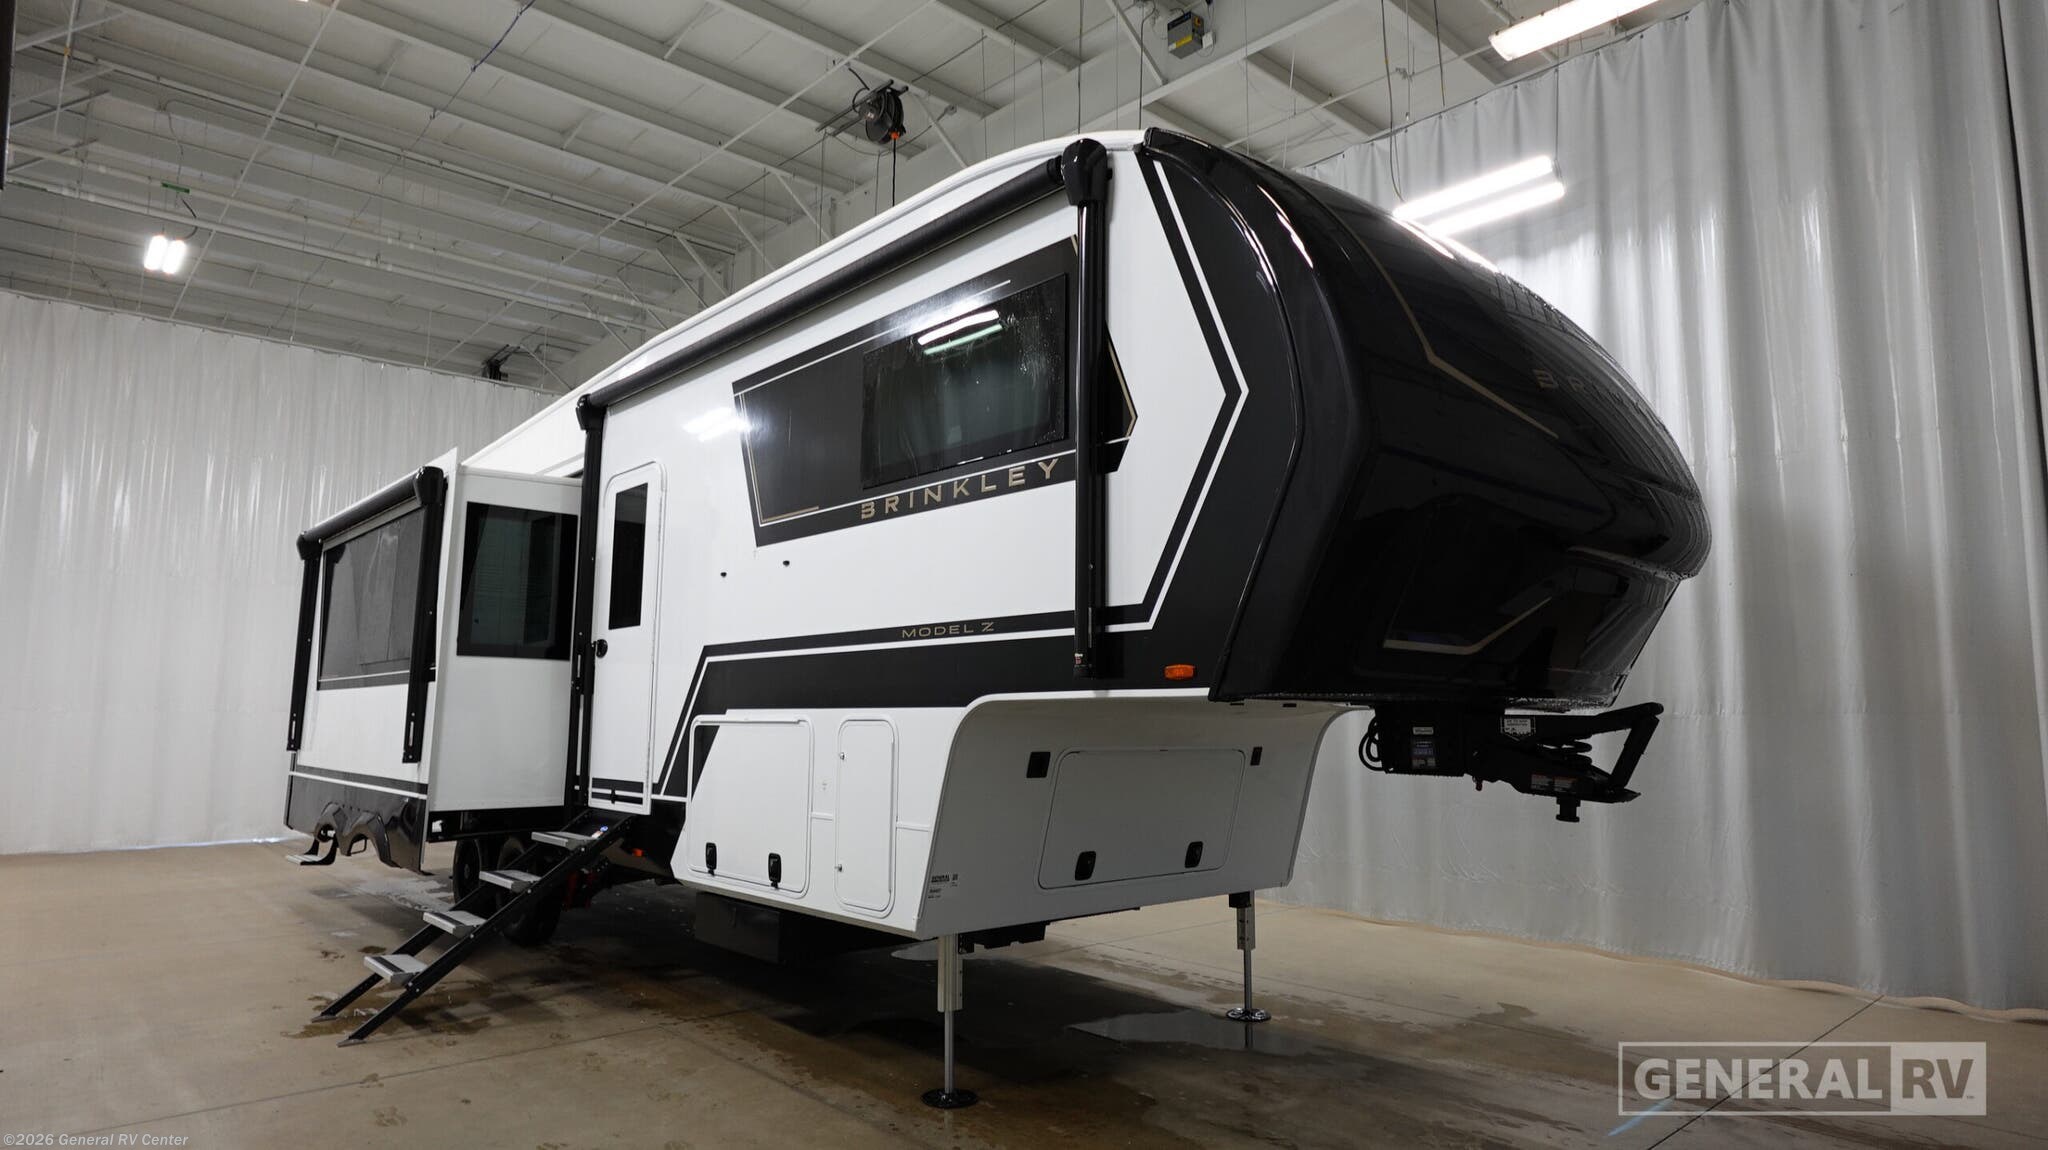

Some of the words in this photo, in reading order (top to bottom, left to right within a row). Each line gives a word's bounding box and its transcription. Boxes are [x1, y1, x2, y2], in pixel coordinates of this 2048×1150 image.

[861, 458, 1059, 520] BRINKLEY
[901, 623, 974, 639] MODEL
[981, 621, 995, 633] Z
